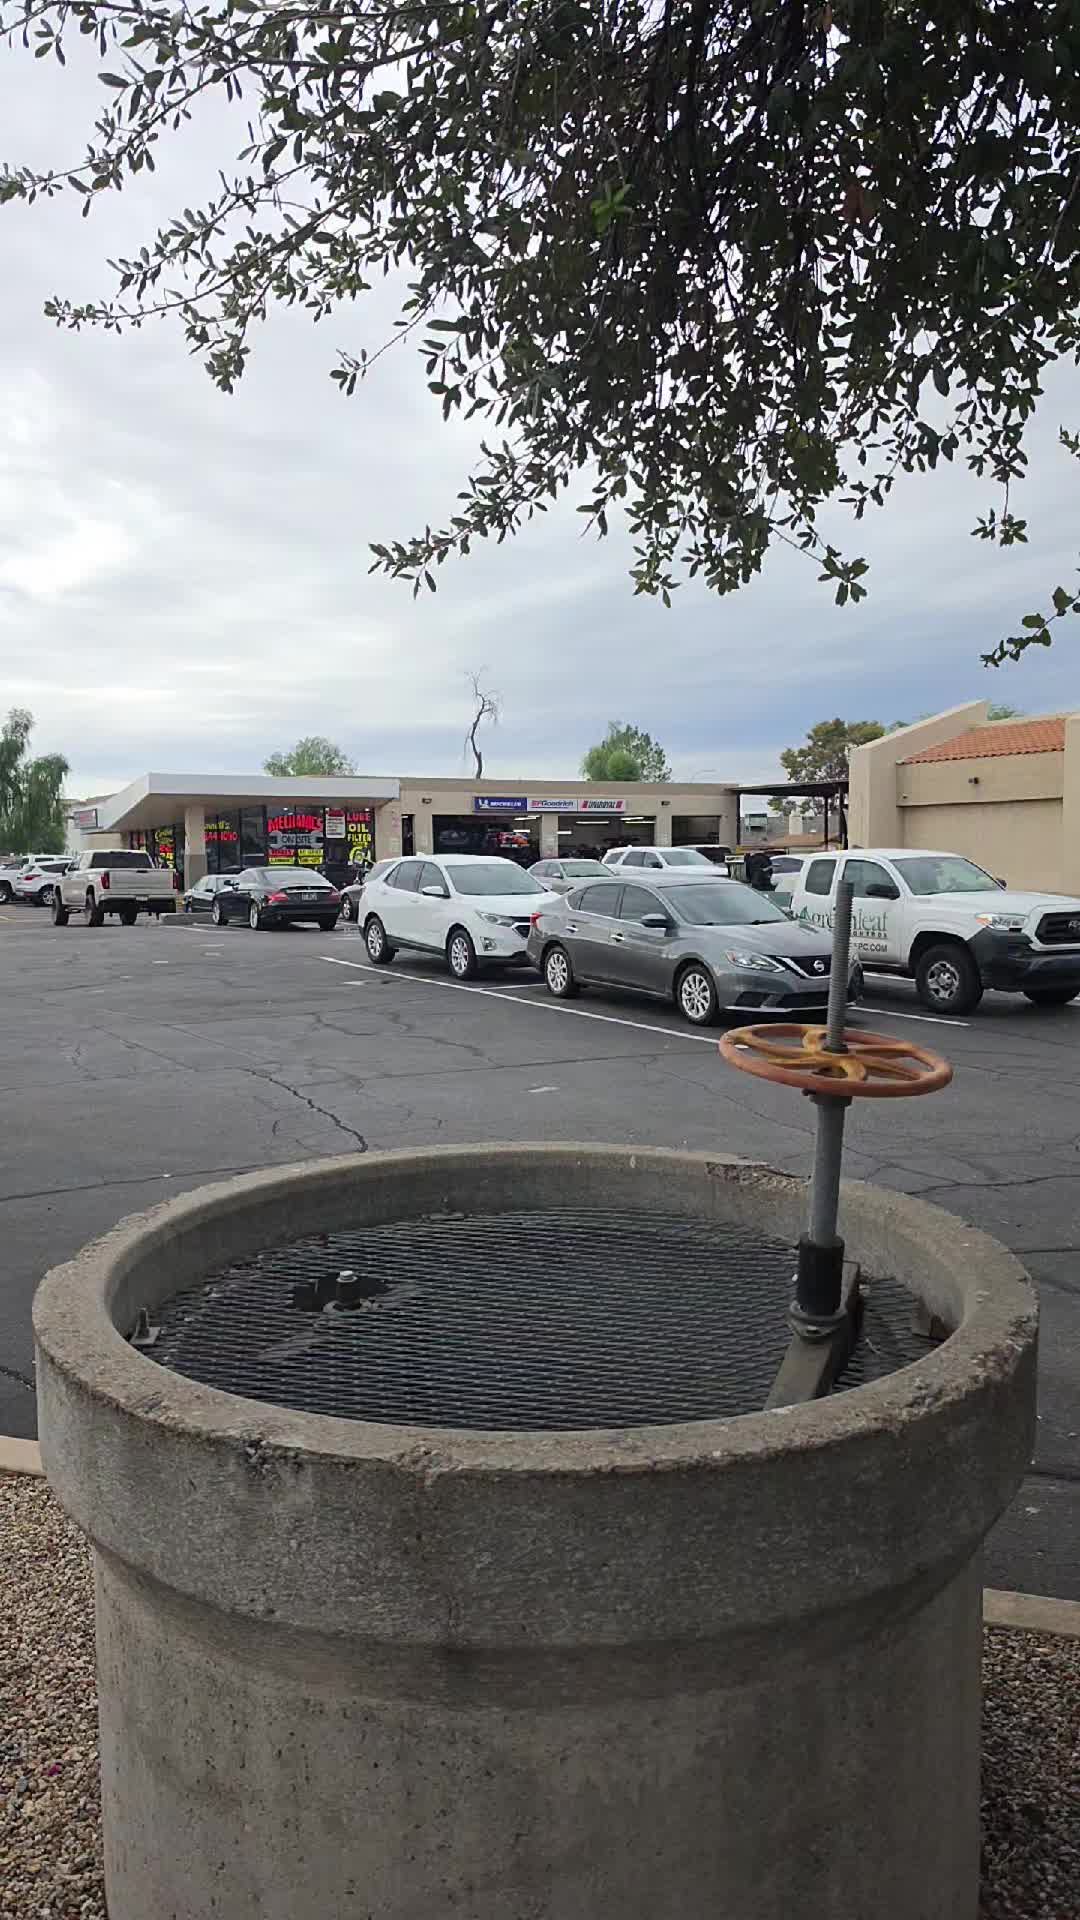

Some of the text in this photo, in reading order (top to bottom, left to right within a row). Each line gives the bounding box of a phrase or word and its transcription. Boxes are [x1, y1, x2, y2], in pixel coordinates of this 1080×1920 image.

[267, 814, 324, 833] MECHANICS
[348, 823, 369, 833] OIL
[347, 833, 372, 842] FILTER
